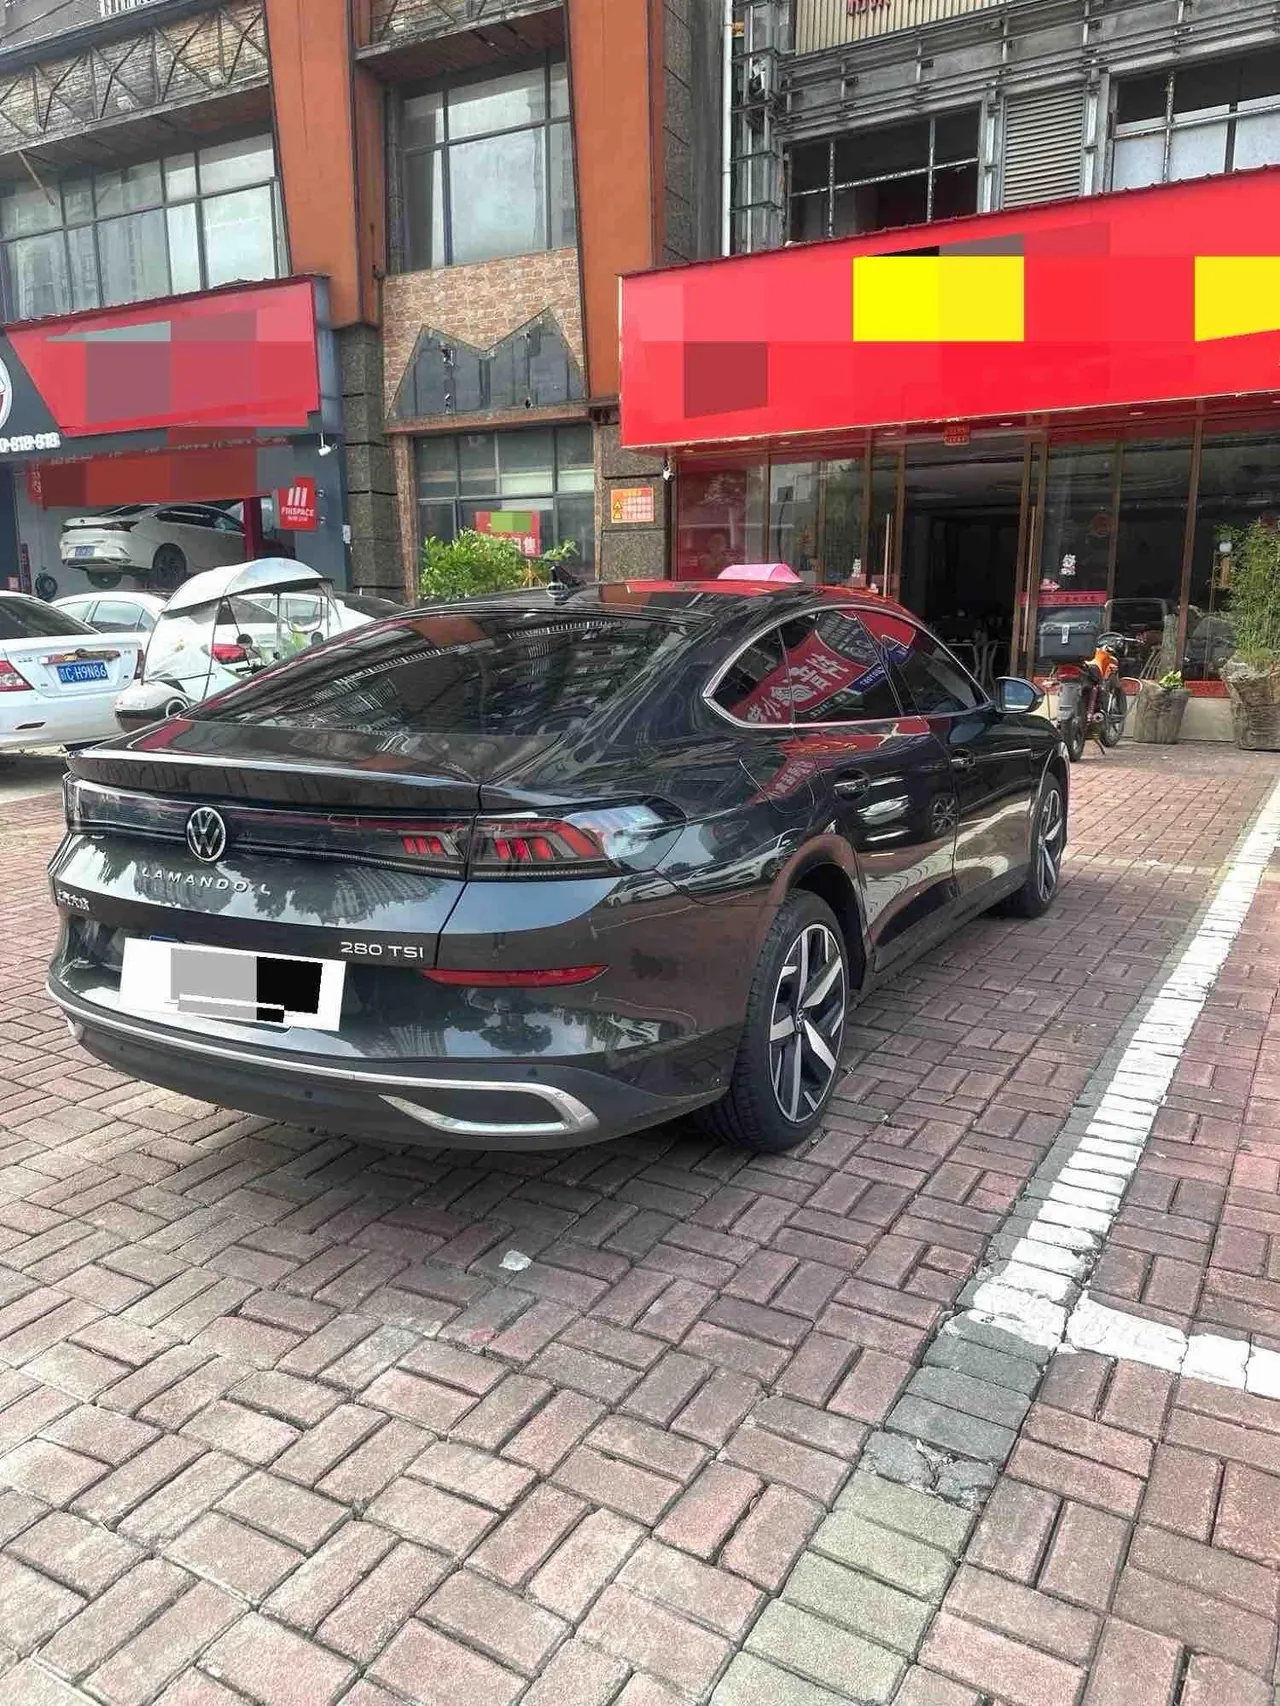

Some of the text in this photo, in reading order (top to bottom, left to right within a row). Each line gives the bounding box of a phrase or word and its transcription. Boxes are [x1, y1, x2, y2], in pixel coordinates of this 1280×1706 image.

[142, 867, 248, 892] LAMANDO
[340, 941, 424, 959] 280 TSI
